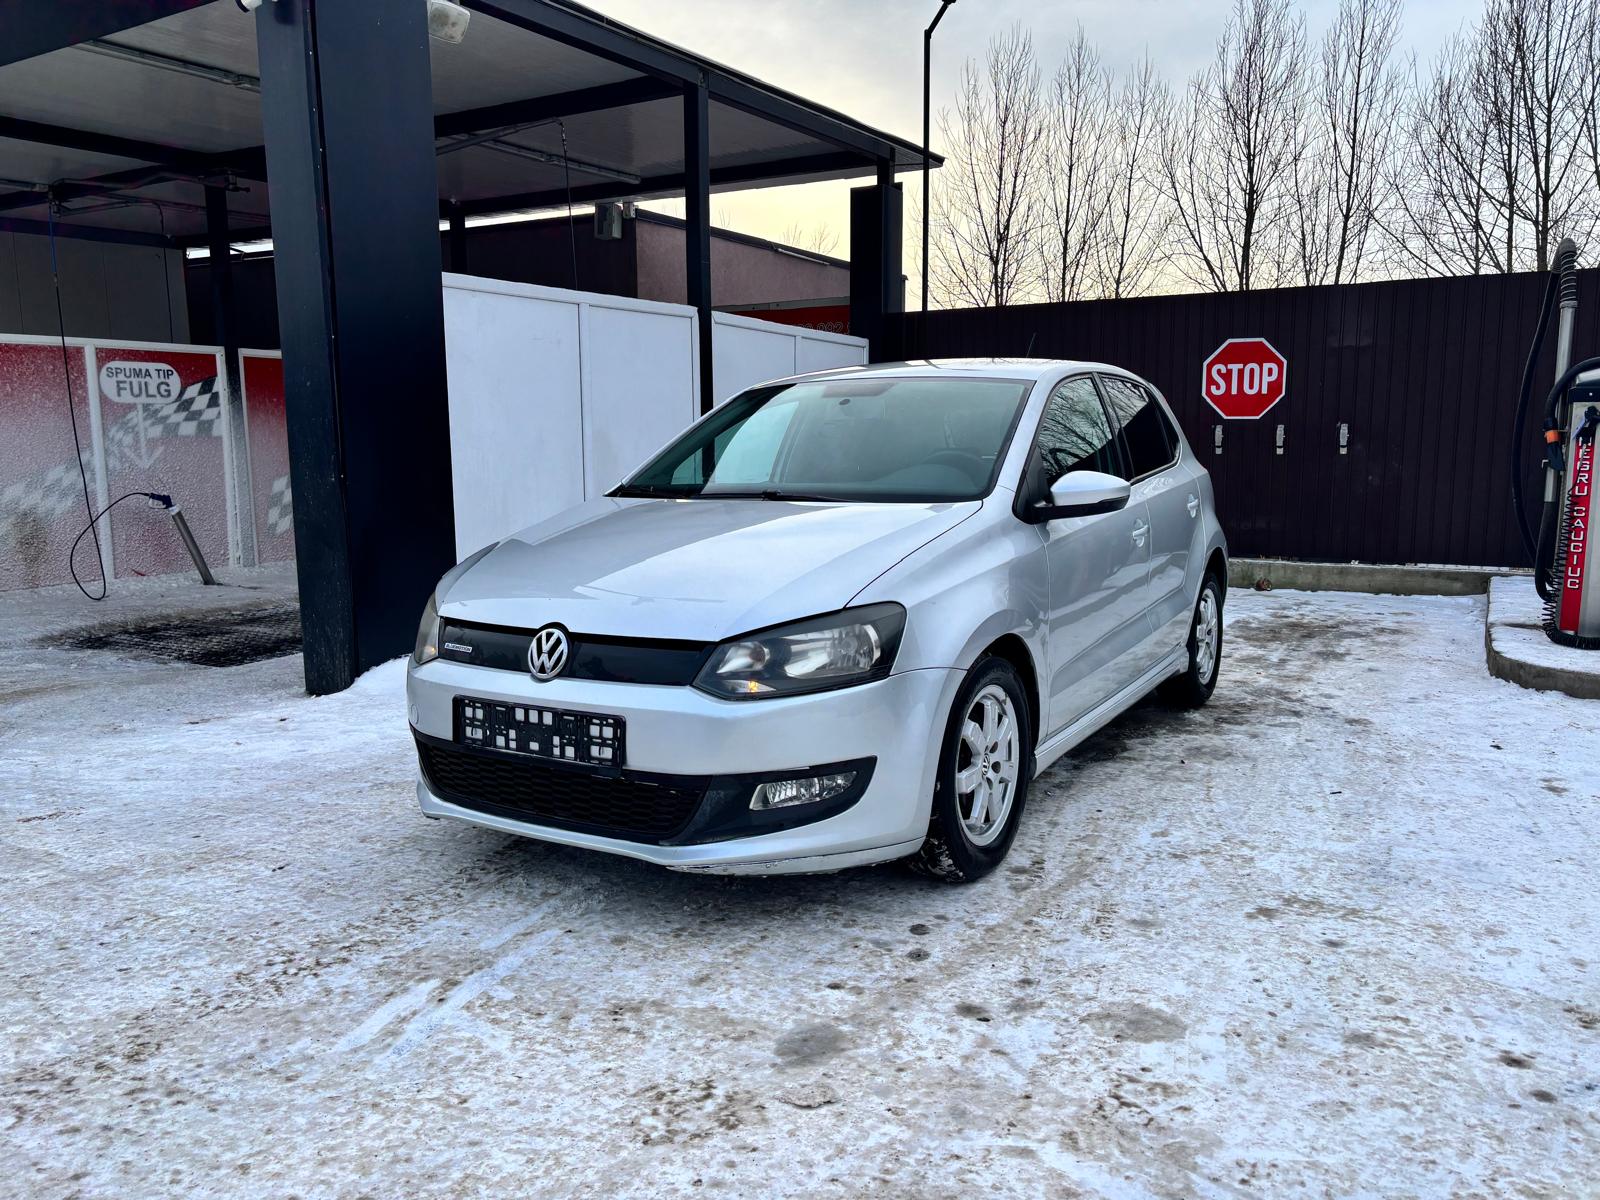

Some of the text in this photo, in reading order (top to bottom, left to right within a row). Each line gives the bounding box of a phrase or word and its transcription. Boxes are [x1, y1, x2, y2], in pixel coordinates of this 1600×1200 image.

[106, 366, 174, 380] SPUMA TIP
[116, 380, 172, 398] FULG
[1210, 362, 1279, 396] STOP
[1567, 506, 1586, 589] CAUCIUC
[529, 629, 568, 679] VW
